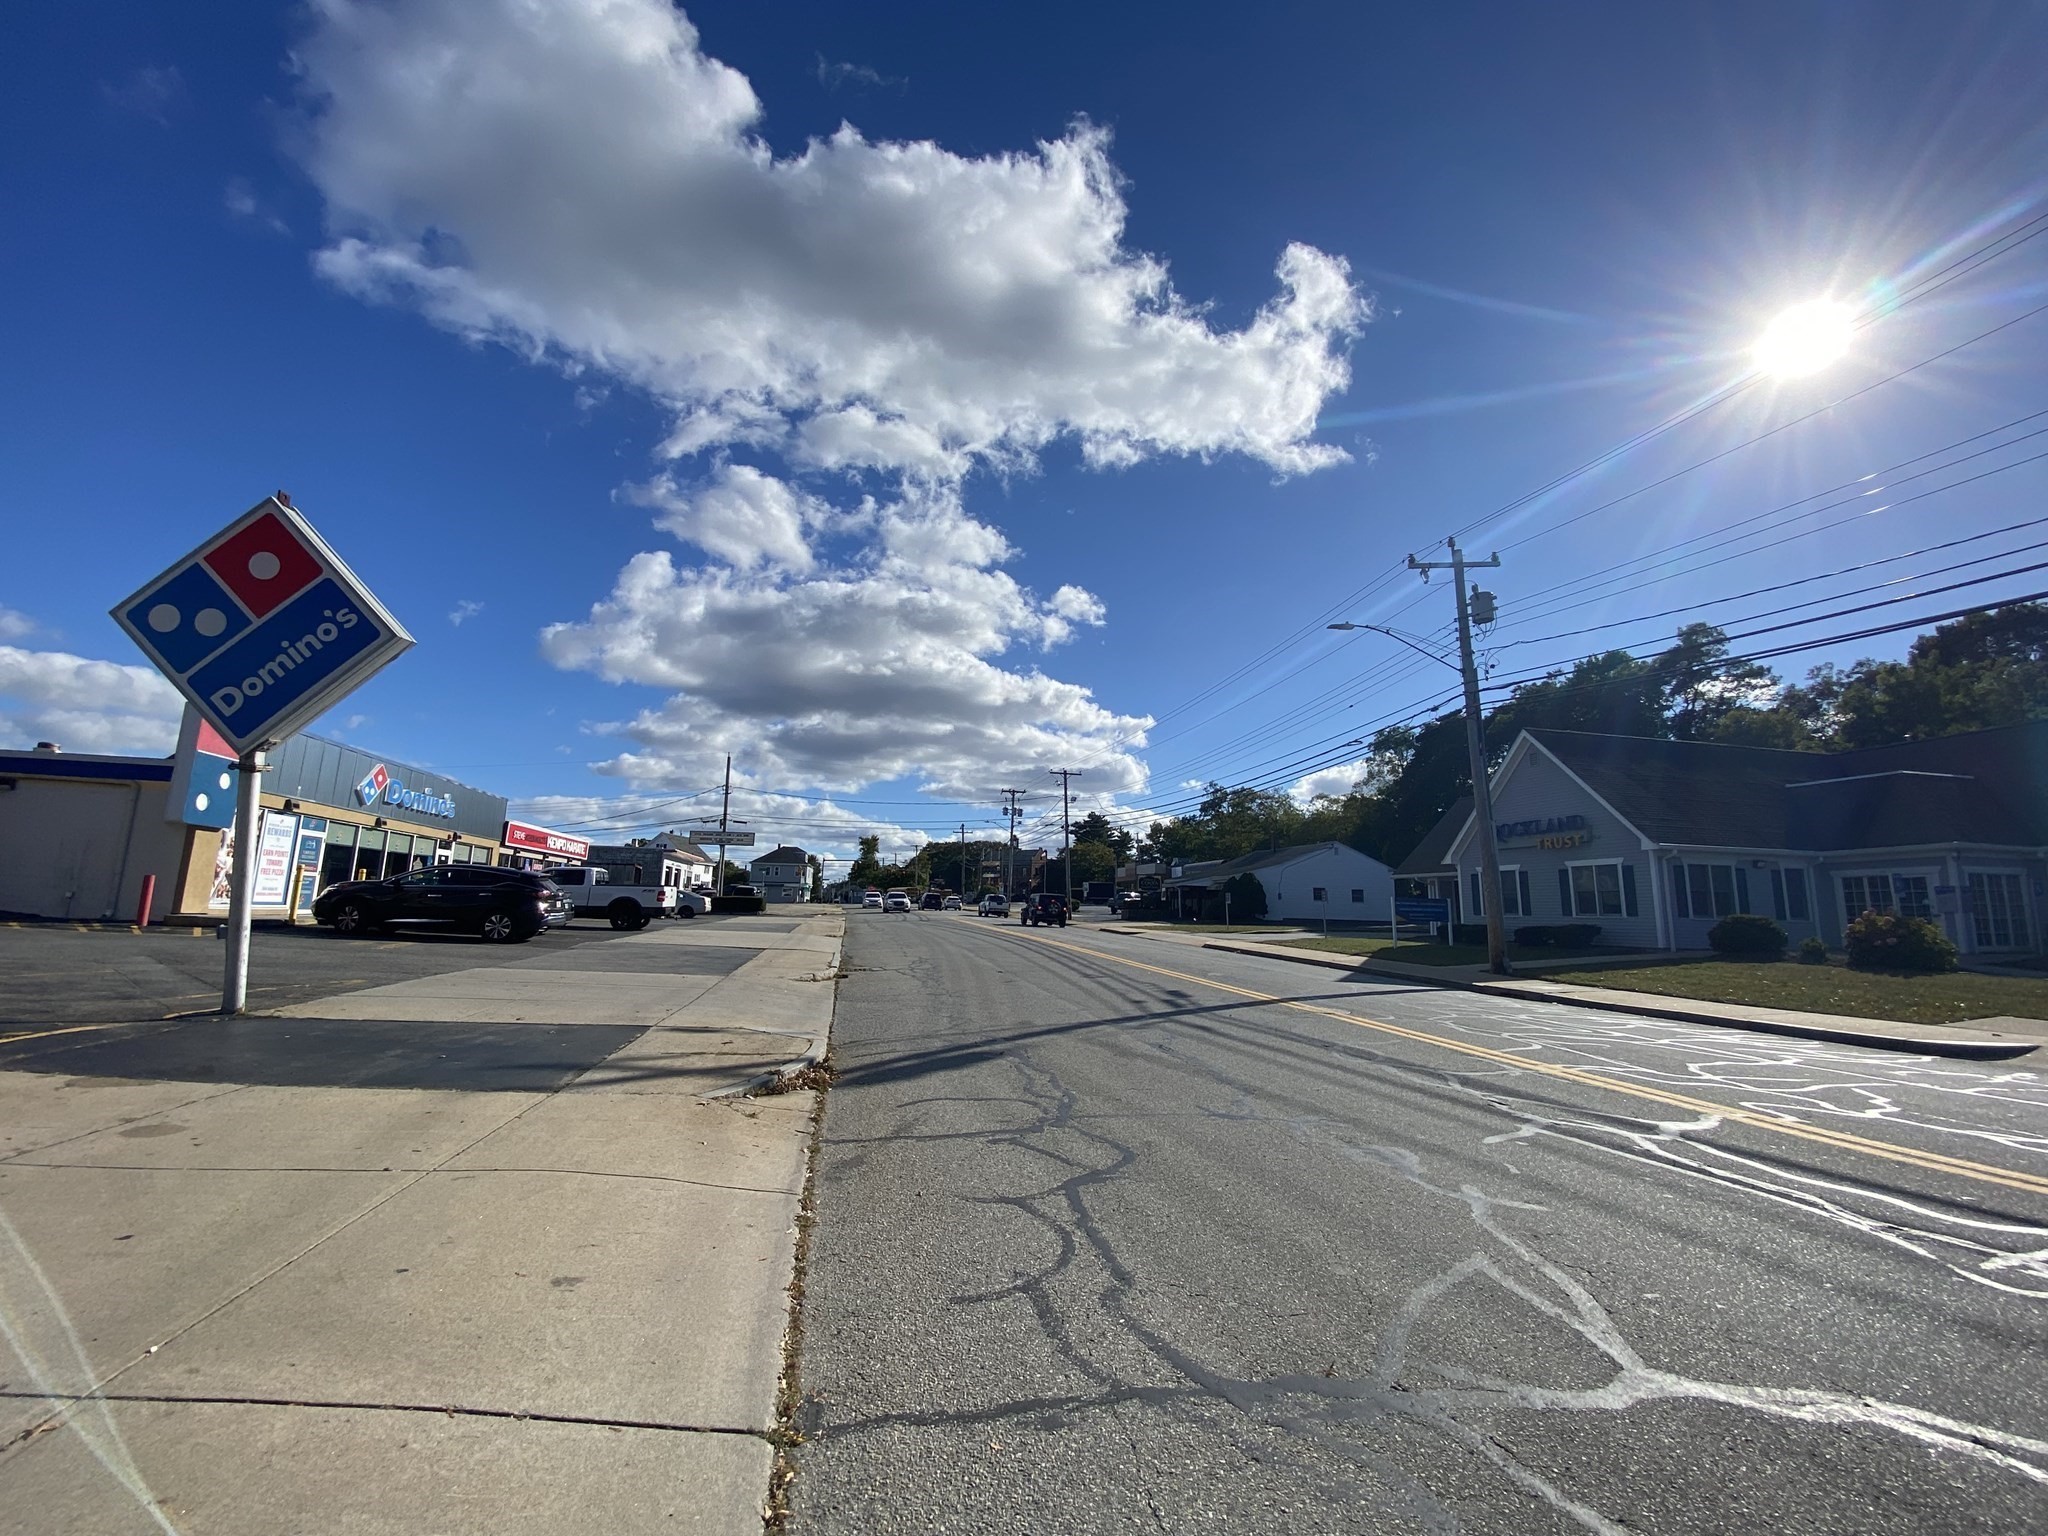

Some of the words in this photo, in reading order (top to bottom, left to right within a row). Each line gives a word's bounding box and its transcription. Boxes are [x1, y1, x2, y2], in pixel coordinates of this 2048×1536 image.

[210, 607, 359, 717] Domino's
[385, 778, 456, 818] Domino's
[1536, 832, 1582, 849] TRUST
